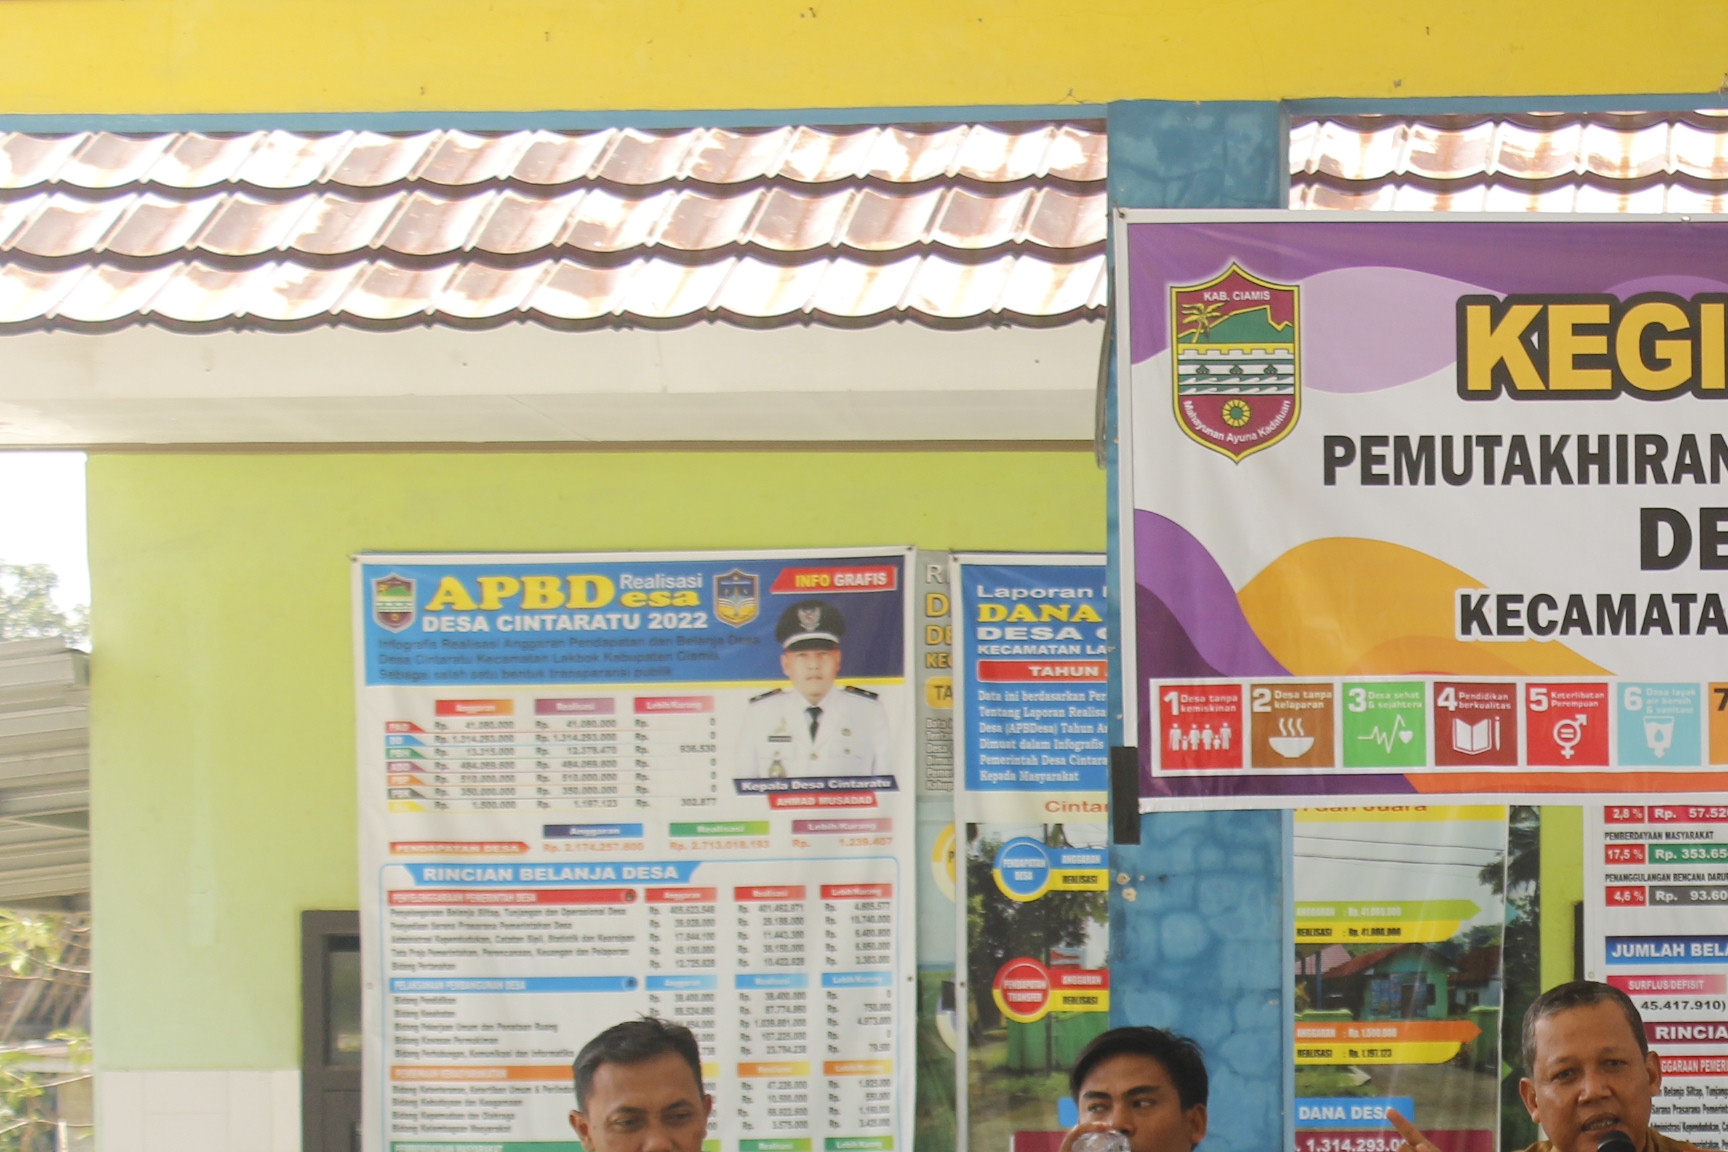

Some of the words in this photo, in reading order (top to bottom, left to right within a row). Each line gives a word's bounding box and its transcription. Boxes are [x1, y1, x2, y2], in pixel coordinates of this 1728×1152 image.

[1204, 292, 1230, 300] KAB.
[1233, 291, 1270, 300] CIAMIS
[1184, 400, 1224, 441] Mahayunan
[1226, 433, 1258, 444] Ayuna
[1258, 400, 1291, 437] Kadatuan
[620, 573, 703, 589] Realisasi
[796, 575, 830, 587] INFO
[834, 572, 887, 586] GRAFIS
[424, 574, 615, 611] APBD
[620, 589, 700, 607] esa
[977, 585, 1093, 600] Laporan
[977, 604, 1103, 622] DANA
[422, 616, 490, 632] DESA
[496, 613, 641, 631] CINTARATU
[648, 611, 708, 629] 2022
[977, 627, 1083, 640] DESA
[978, 645, 1081, 655] KECAMATAN
[1029, 666, 1099, 677] TAHUN
[1181, 694, 1206, 703] Desa
[1209, 694, 1238, 704] tanpa
[1253, 688, 1272, 712] 2
[1274, 690, 1299, 699] Desa
[1303, 691, 1332, 700] tanpa
[1348, 688, 1366, 712] 3
[1392, 691, 1420, 699] sehat
[1437, 687, 1457, 711] 4
[1459, 692, 1508, 700] Pendidikan
[1529, 688, 1548, 711] 5
[1551, 691, 1604, 699] Keterlibatan
[1623, 687, 1642, 711] 6
[1164, 692, 1179, 715] 1
[1181, 704, 1236, 713] kemiskinan
[1274, 700, 1324, 710] kelaparan
[1378, 700, 1422, 709] sejahtera
[1459, 701, 1511, 709] berkualitas
[1551, 700, 1599, 708] Perempuan
[741, 781, 788, 792] Kepala
[792, 780, 824, 790] Desa
[828, 779, 891, 789] Cintaratu
[1613, 809, 1630, 819] 2,8
[1654, 809, 1677, 820] Rp.
[1604, 832, 1663, 840] PEMBERDAYAAN
[1665, 831, 1713, 840] MASYARAKAT
[1608, 850, 1631, 860] 17,5
[1655, 850, 1677, 861] Rp.
[423, 867, 512, 882] RINCIAN
[519, 866, 615, 881] BELANJA
[622, 866, 678, 880] DESA
[1612, 944, 1685, 957] JUMLAH
[1299, 1107, 1346, 1119] DANA
[1307, 1138, 1408, 1152] 1.314.293.0
